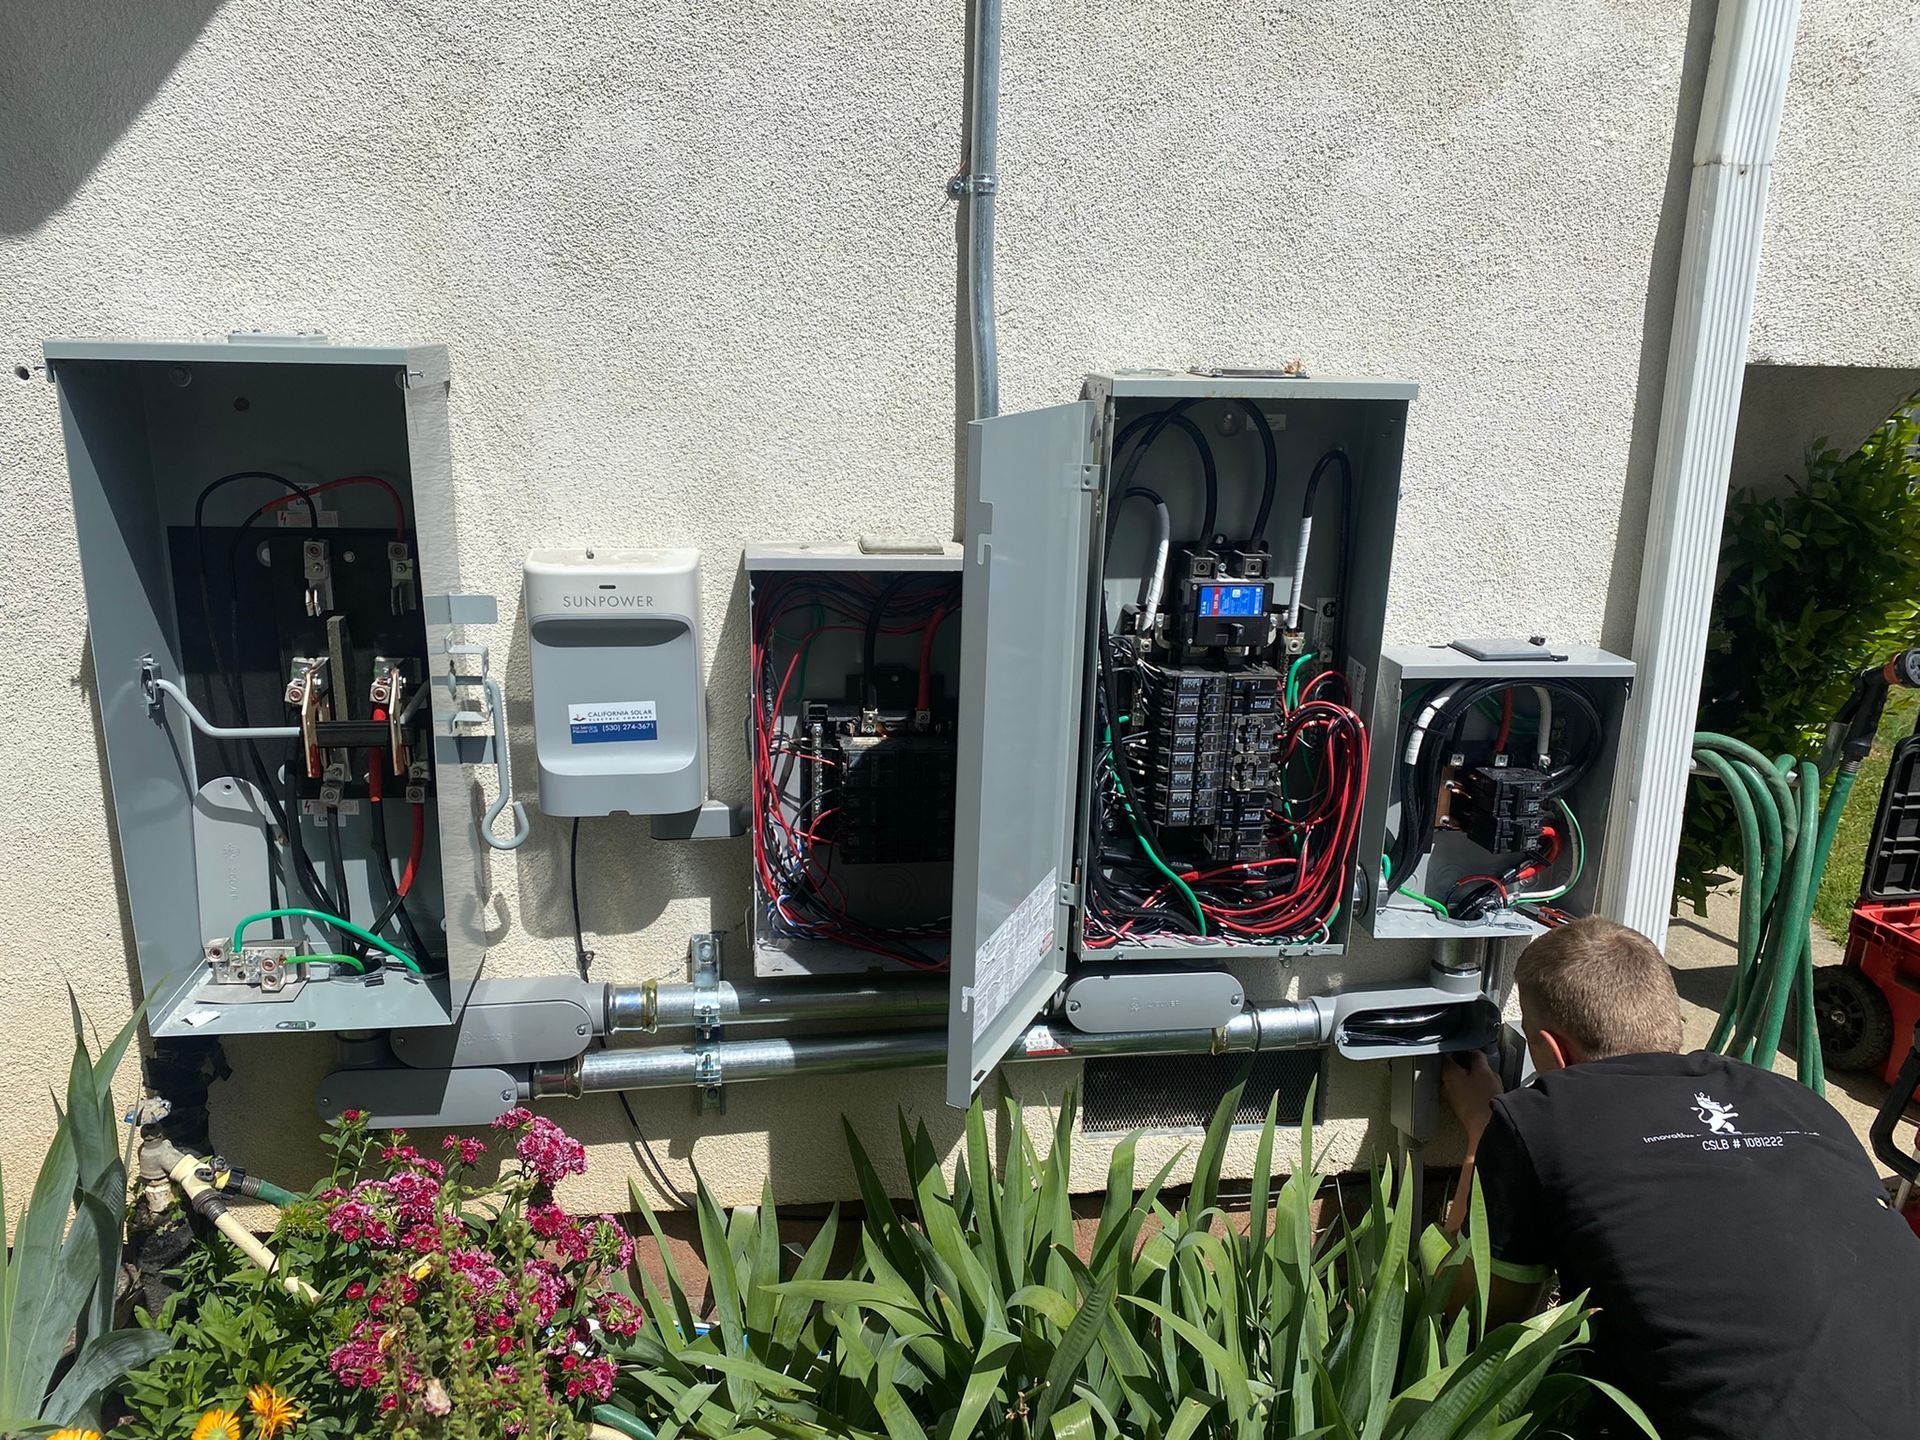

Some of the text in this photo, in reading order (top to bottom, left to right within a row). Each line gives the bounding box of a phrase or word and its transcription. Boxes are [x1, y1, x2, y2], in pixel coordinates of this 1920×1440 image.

[563, 595, 654, 608] SUNPOWER
[587, 710, 629, 718] CALIFORNIA
[602, 722, 654, 733] (530) 274-3671
[1702, 1136, 1784, 1151] CSLB # 1081222
